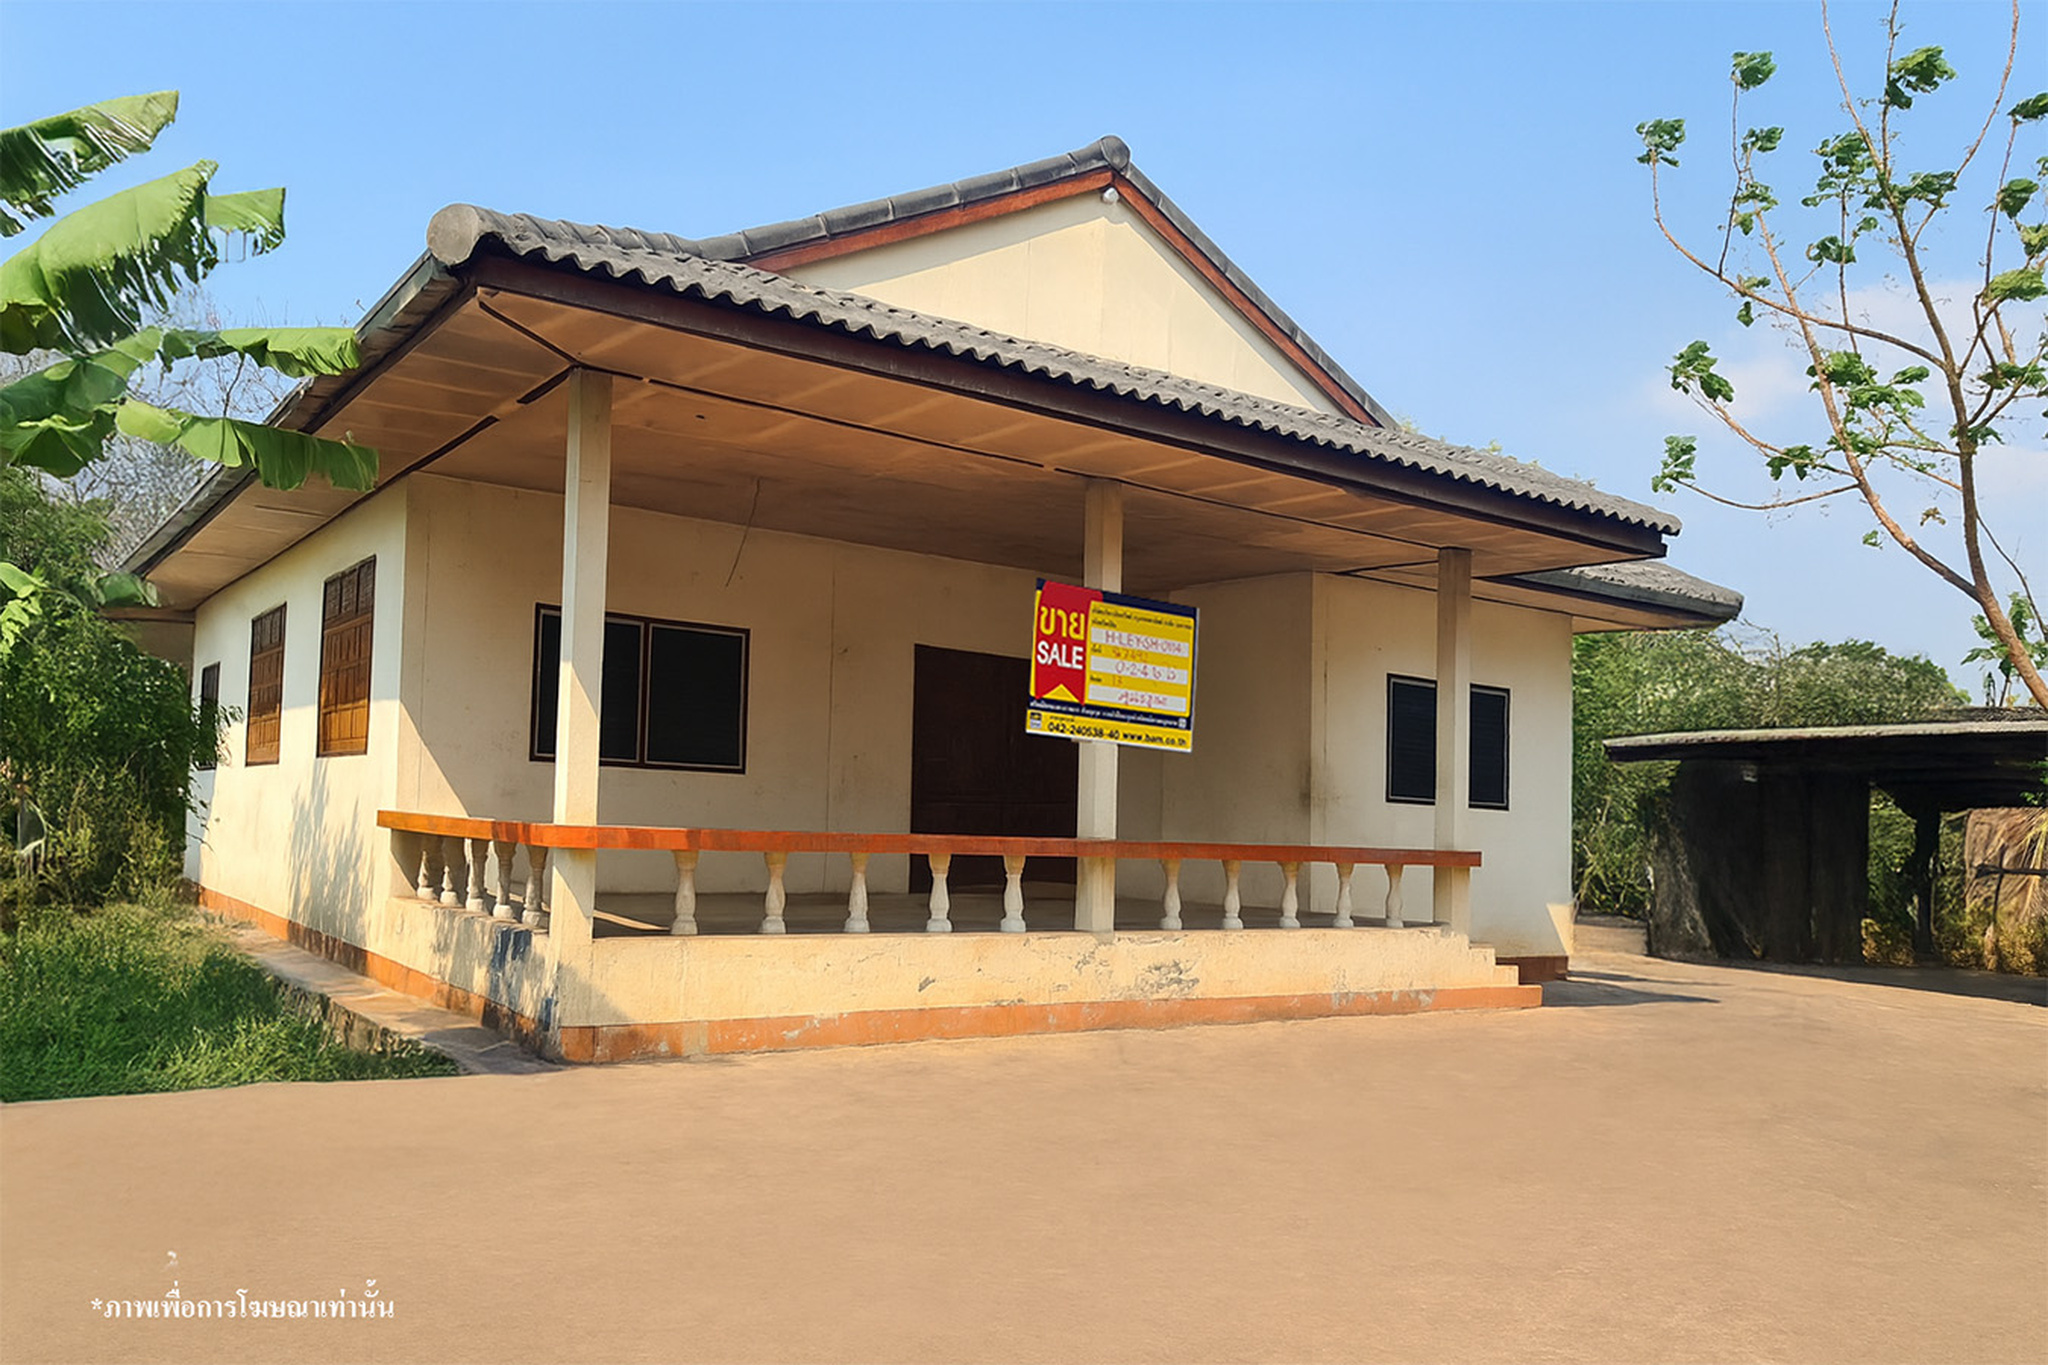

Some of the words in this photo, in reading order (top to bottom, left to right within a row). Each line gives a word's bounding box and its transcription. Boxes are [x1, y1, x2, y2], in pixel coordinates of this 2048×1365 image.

[1039, 605, 1086, 641] ขาย
[1036, 640, 1084, 670] SALE
[1122, 731, 1187, 746] www.bam.co.th
